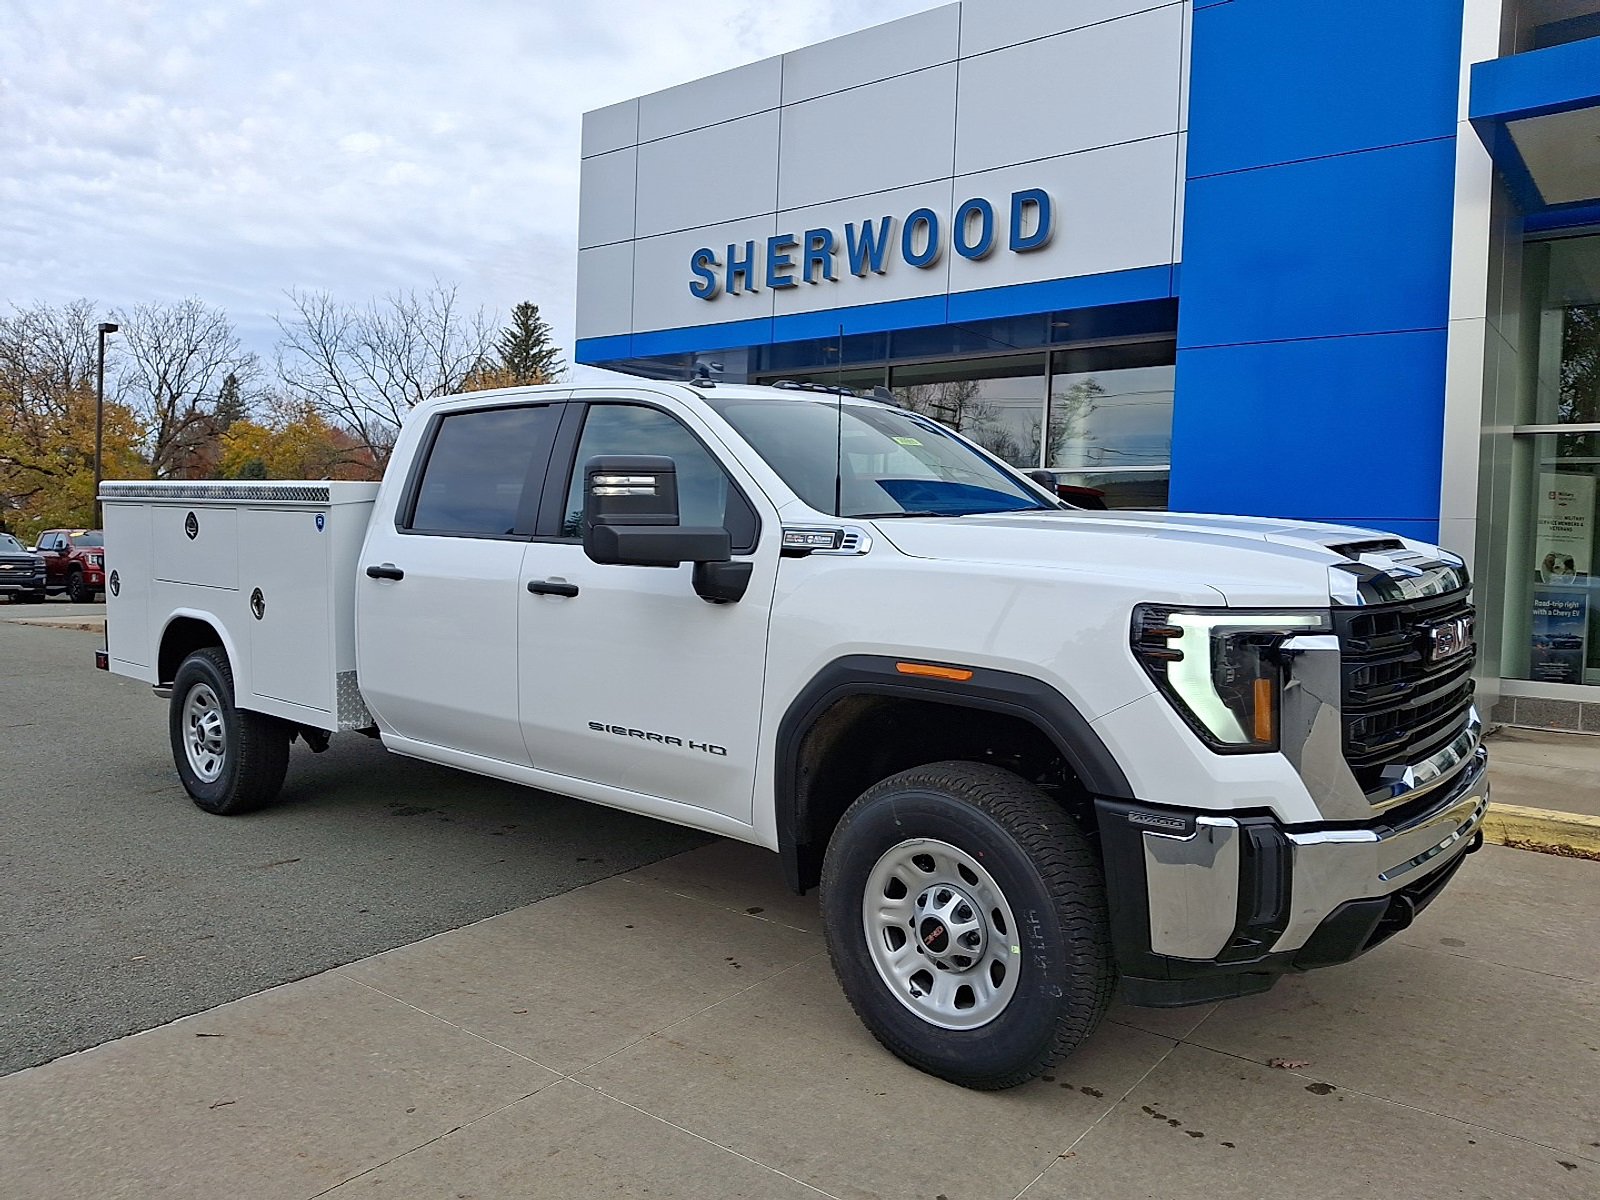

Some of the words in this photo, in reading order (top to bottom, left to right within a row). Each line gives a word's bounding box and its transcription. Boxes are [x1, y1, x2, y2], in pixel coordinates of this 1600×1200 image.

[689, 187, 1054, 300] SHERWOOD
[1534, 600, 1564, 608] Road-trip
[1564, 601, 1580, 609] right
[1552, 609, 1571, 617] Chevy
[588, 720, 682, 746] SIERRA
[688, 740, 727, 756] HD
